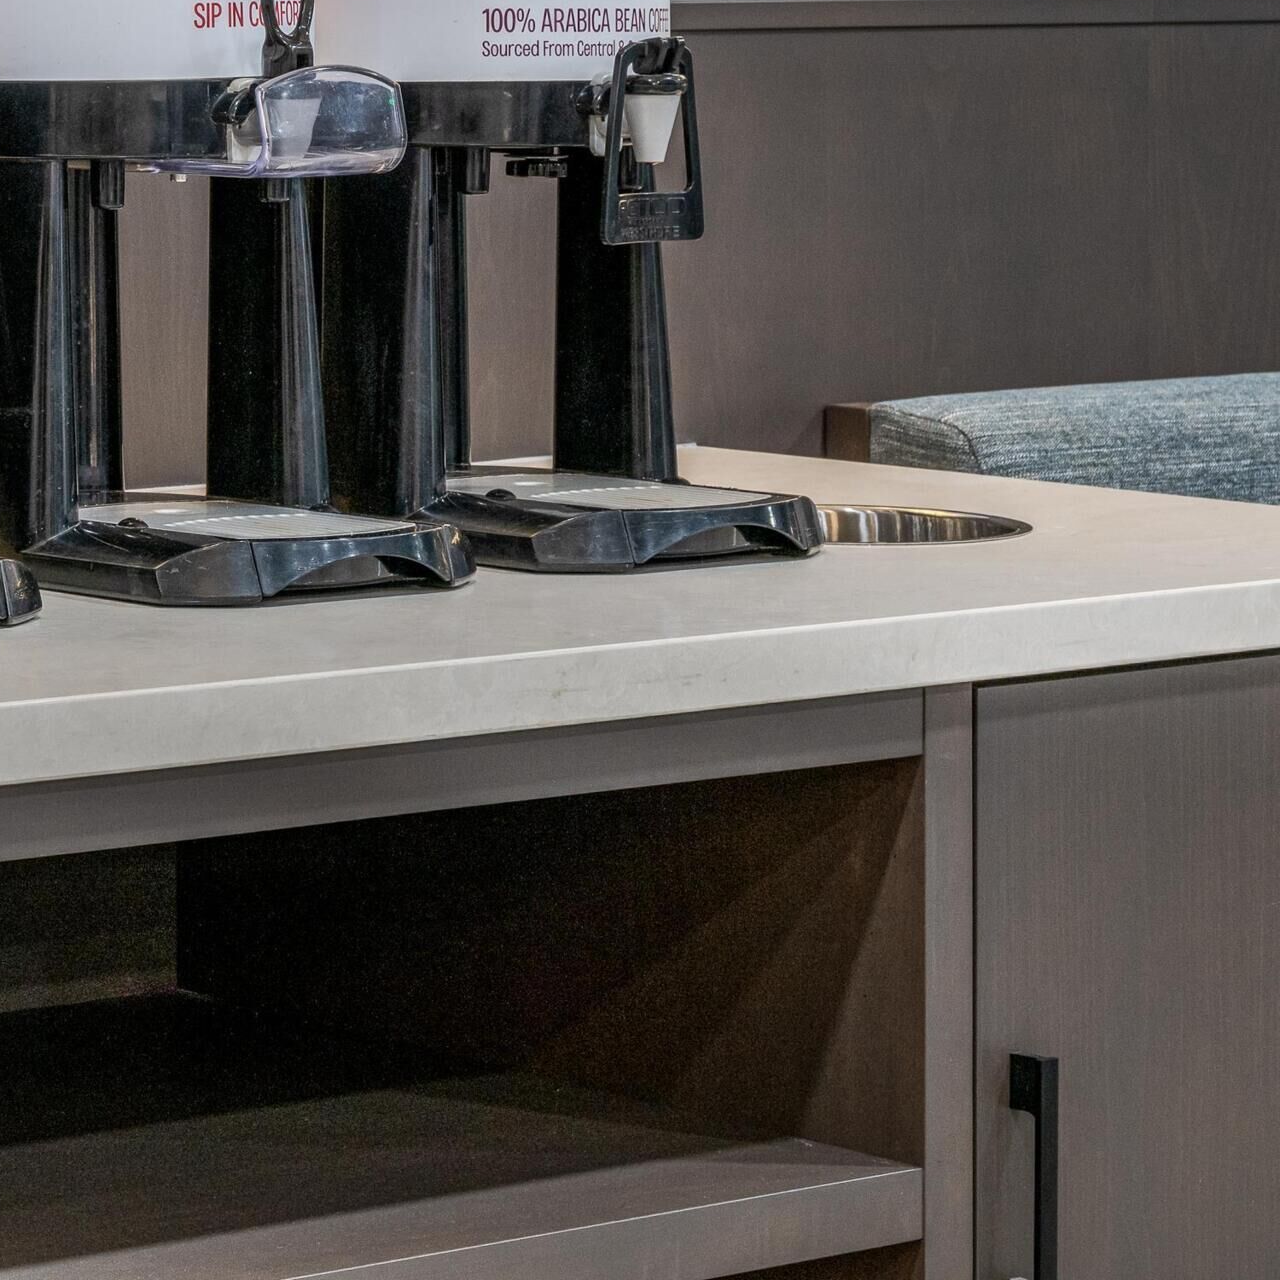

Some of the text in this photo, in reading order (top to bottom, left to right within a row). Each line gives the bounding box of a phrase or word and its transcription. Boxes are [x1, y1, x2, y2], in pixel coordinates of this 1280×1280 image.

[193, 1, 222, 29] SIP
[228, 1, 244, 28] IN
[481, 7, 535, 33] 100%
[541, 7, 610, 33] ARABICA
[615, 7, 645, 33] BEAN
[481, 40, 539, 57] Sourced
[543, 40, 574, 57] From
[577, 40, 615, 57] Central
